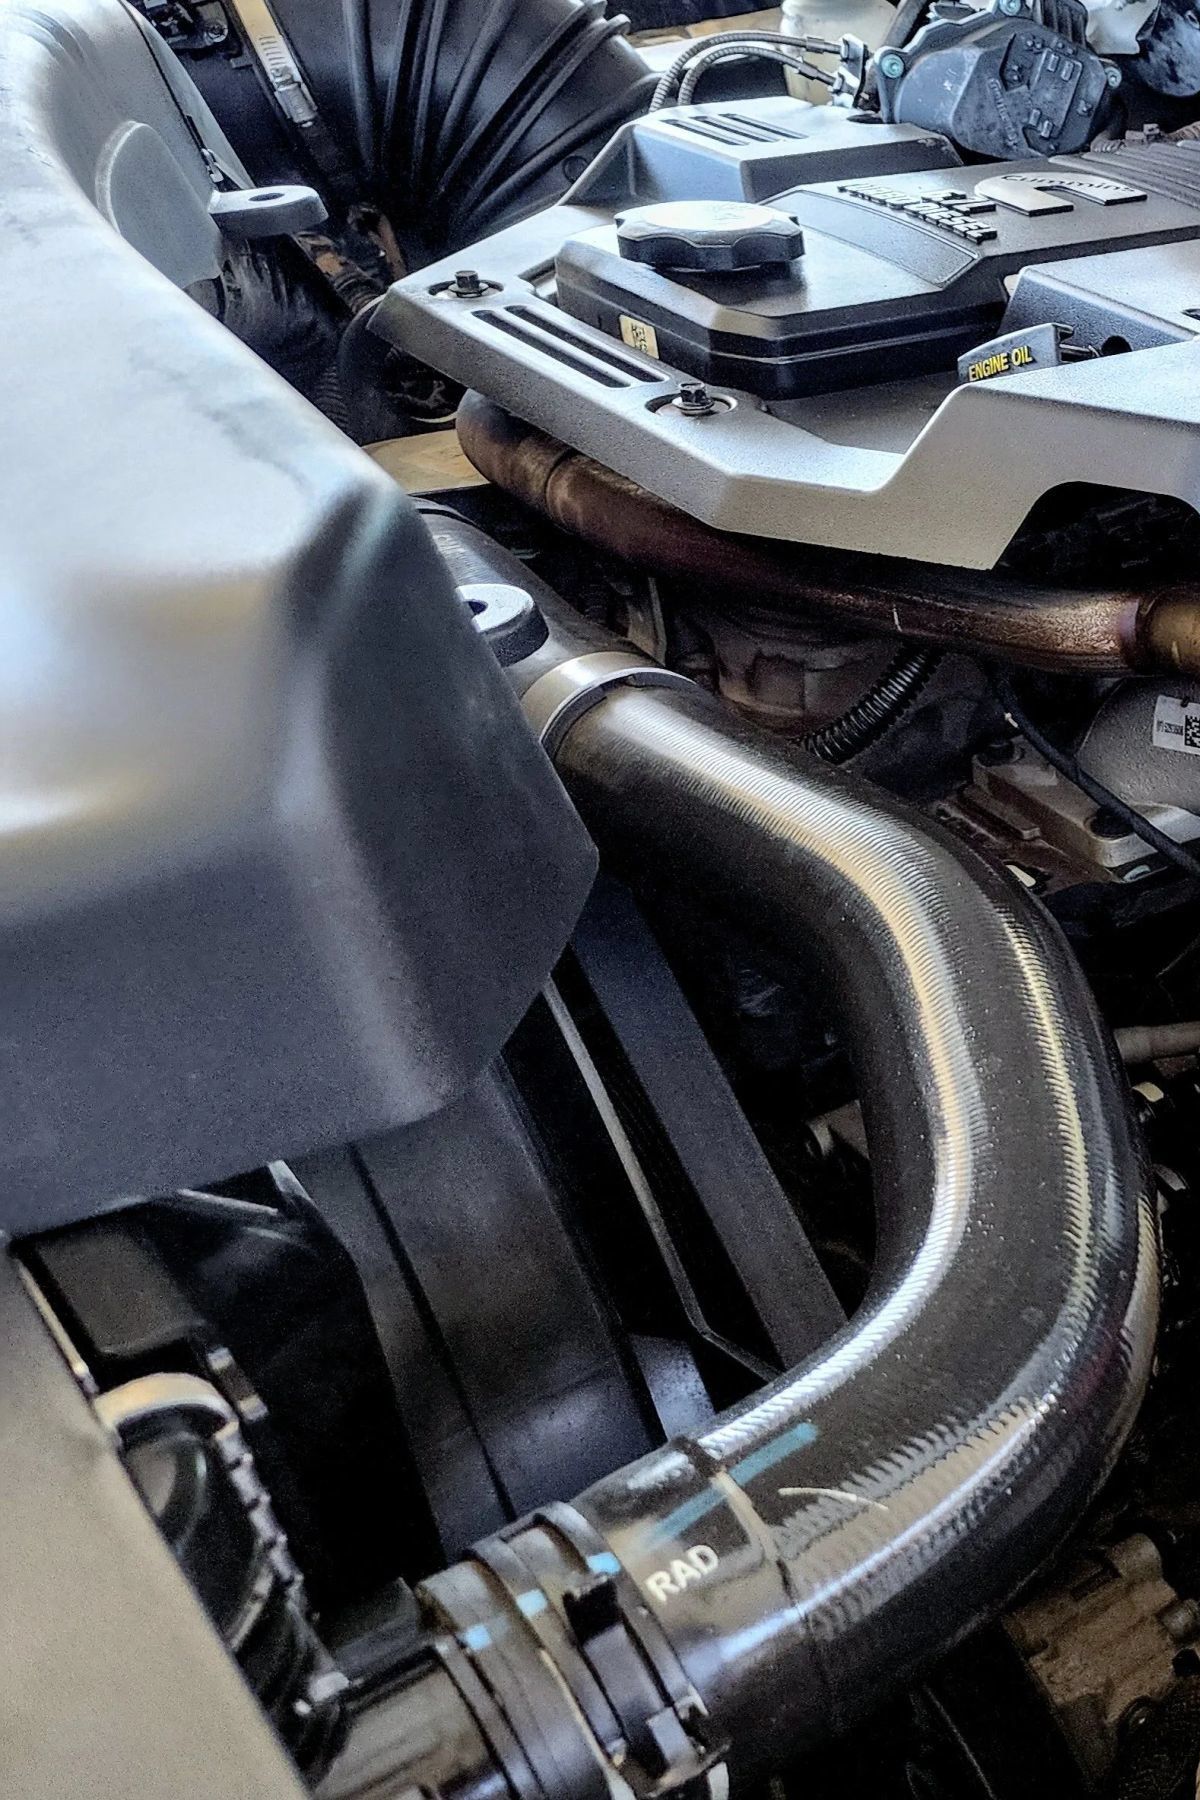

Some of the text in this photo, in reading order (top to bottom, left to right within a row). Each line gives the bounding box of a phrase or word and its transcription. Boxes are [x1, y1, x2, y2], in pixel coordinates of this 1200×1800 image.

[1002, 174, 1136, 193] Cummins
[968, 345, 1034, 382] ENGINE OIL
[646, 1545, 719, 1602] RAD
